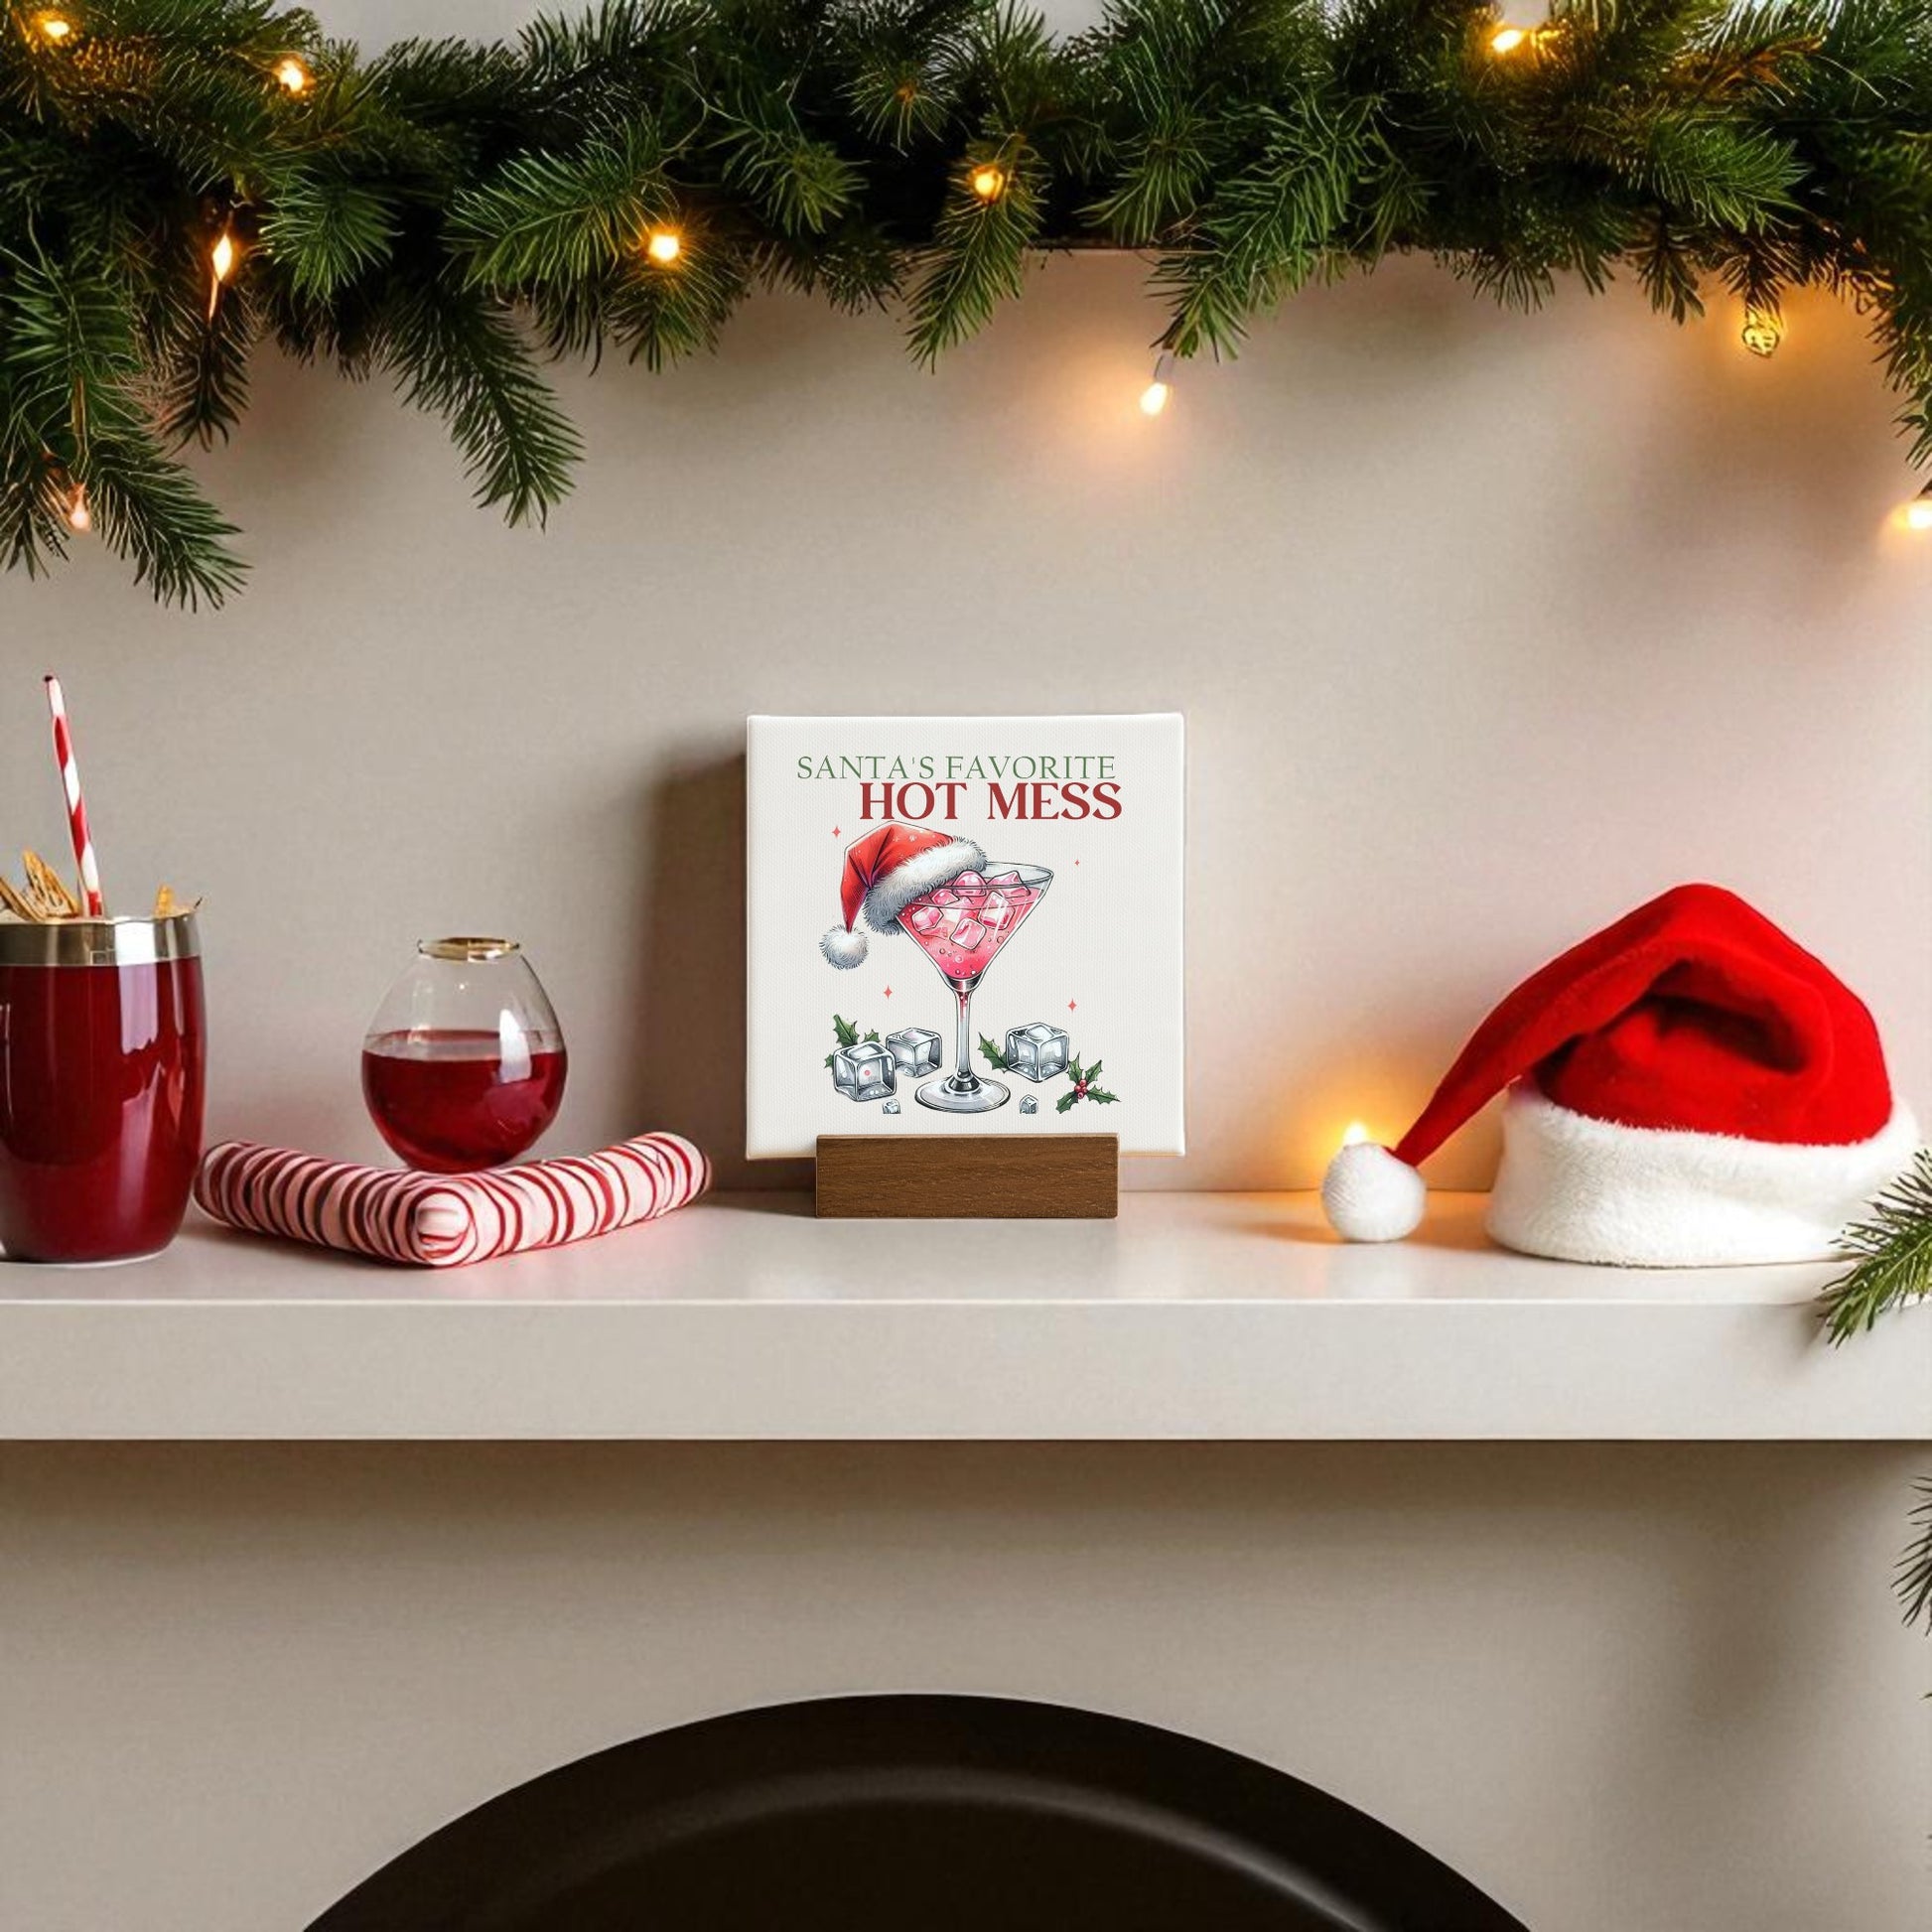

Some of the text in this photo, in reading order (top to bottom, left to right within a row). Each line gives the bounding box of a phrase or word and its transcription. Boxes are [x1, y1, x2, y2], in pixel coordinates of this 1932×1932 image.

[797, 756, 1116, 779] SANTA'S FAVORITE
[860, 781, 1123, 820] HOT MESS
